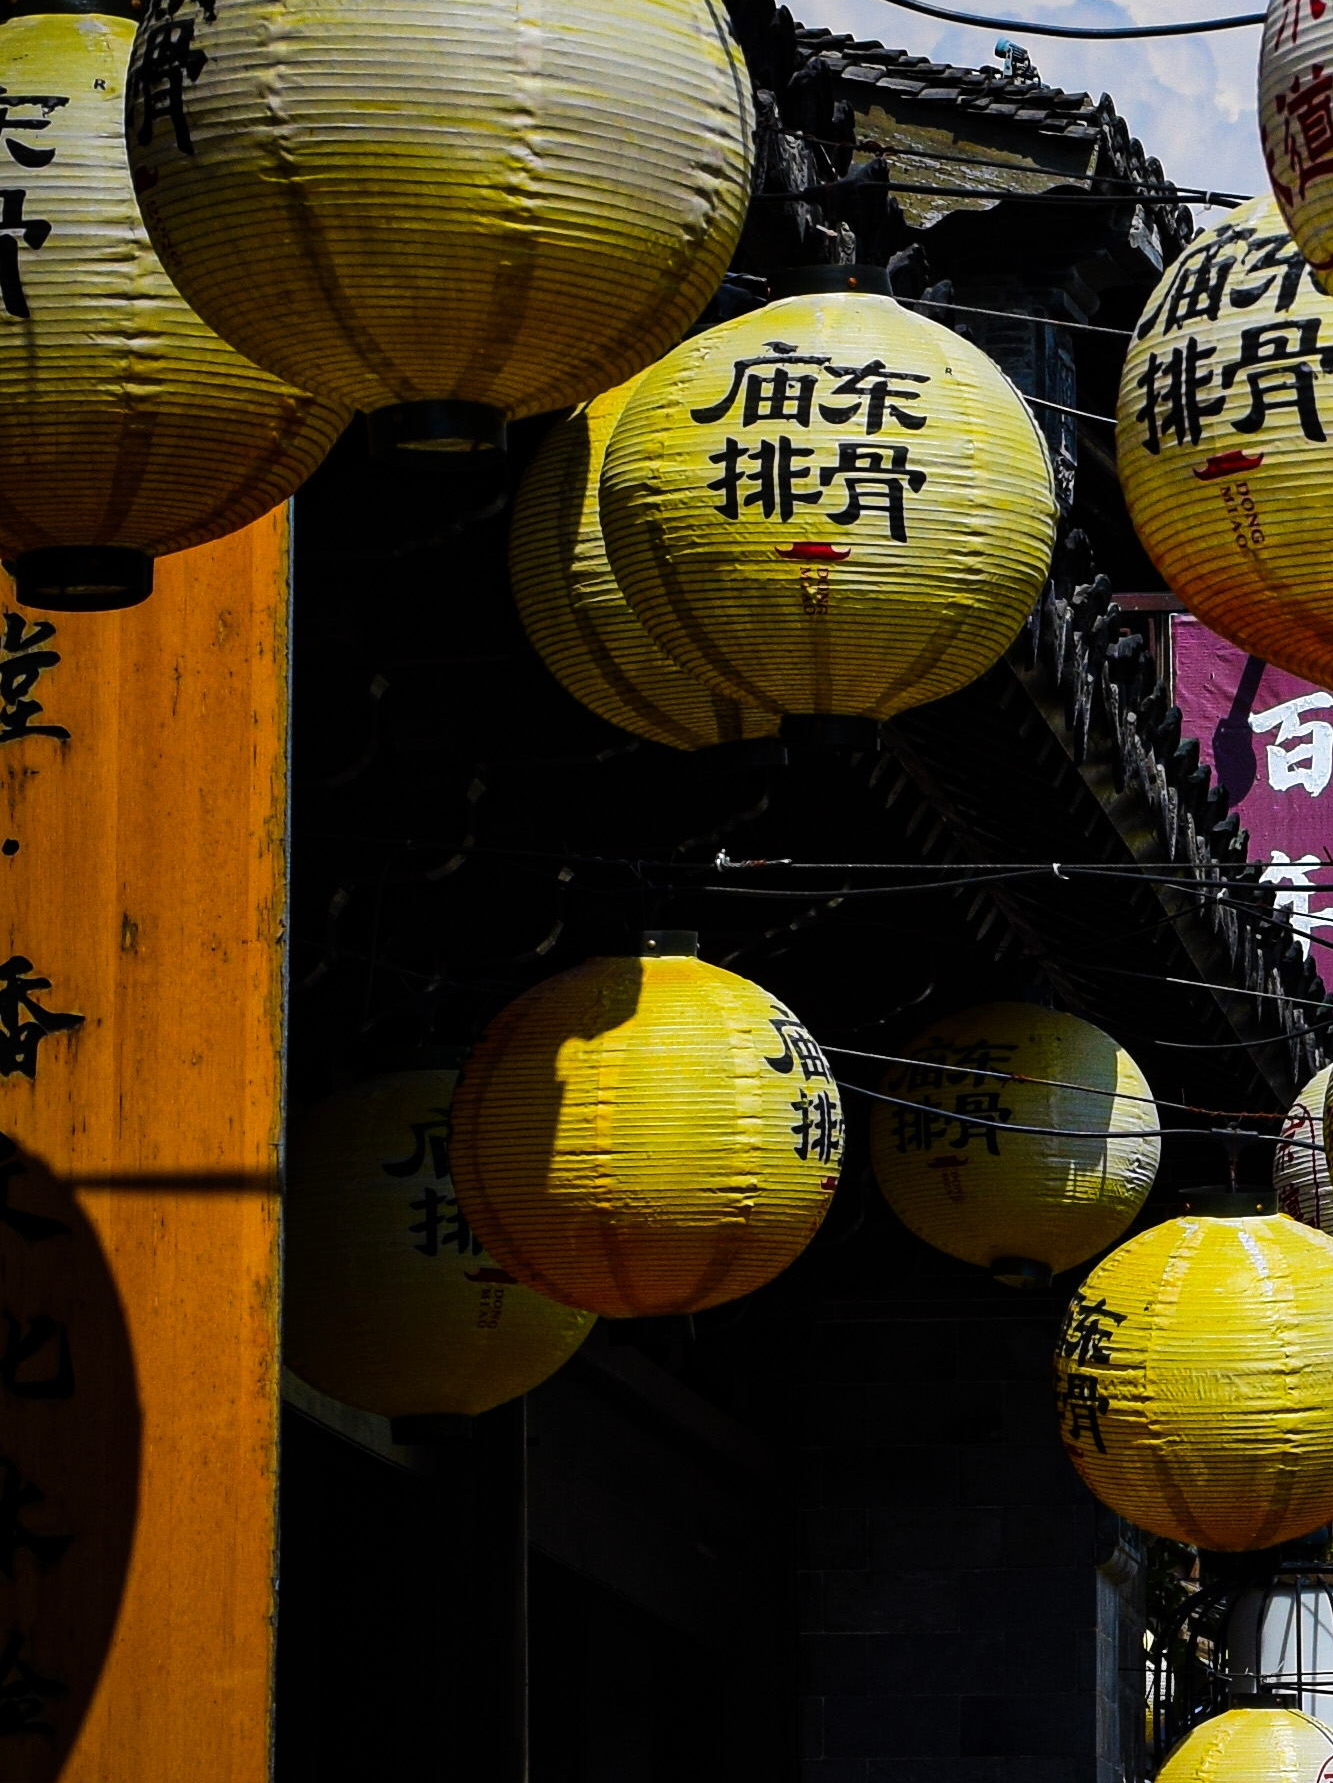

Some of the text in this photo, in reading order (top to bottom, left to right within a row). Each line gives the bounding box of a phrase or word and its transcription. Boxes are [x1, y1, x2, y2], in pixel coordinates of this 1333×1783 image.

[126, 19, 208, 155] 骨
[692, 341, 930, 435] 庙东
[706, 435, 927, 543] 排骨
[1219, 486, 1249, 552] MIAO
[1233, 481, 1267, 545] DONG
[888, 1036, 1018, 1092] 庙东
[791, 1088, 845, 1166] 排
[892, 1092, 1012, 1156] 排骨
[1058, 1291, 1128, 1367] 东
[1056, 1373, 1110, 1454] 骨
